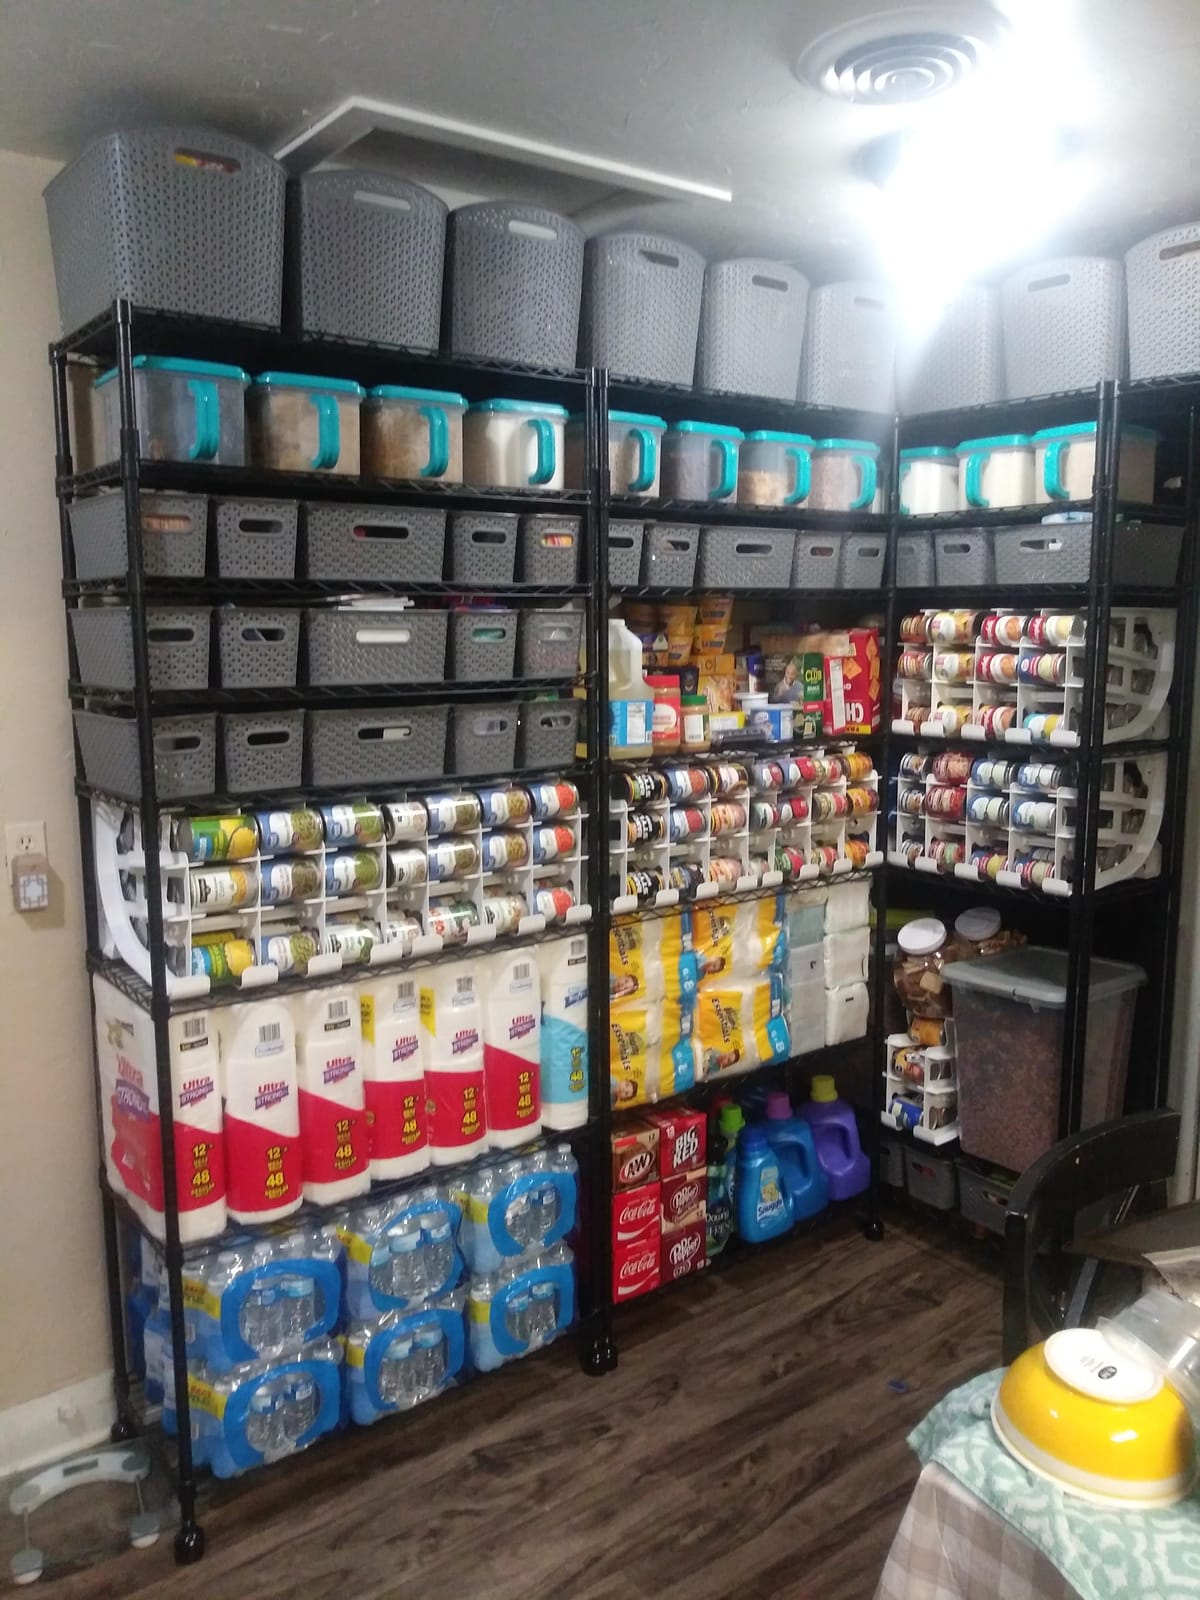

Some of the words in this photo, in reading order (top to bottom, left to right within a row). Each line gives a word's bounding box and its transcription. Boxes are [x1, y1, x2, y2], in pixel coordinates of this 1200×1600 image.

[326, 1056, 352, 1070] Ultra
[518, 1072, 530, 1083] 12
[258, 1081, 286, 1095] Ultra
[463, 1087, 475, 1099] 12
[403, 1096, 415, 1108] 12
[518, 1094, 532, 1107] 48
[463, 1111, 477, 1125] 48
[336, 1120, 349, 1132] 12
[403, 1119, 417, 1134] 48
[676, 1125, 696, 1147] BIG
[193, 1144, 206, 1157] 12
[267, 1147, 281, 1159] 12
[335, 1144, 353, 1159] 48
[673, 1138, 698, 1168] RED
[192, 1170, 210, 1186] 48
[266, 1172, 284, 1187] 48
